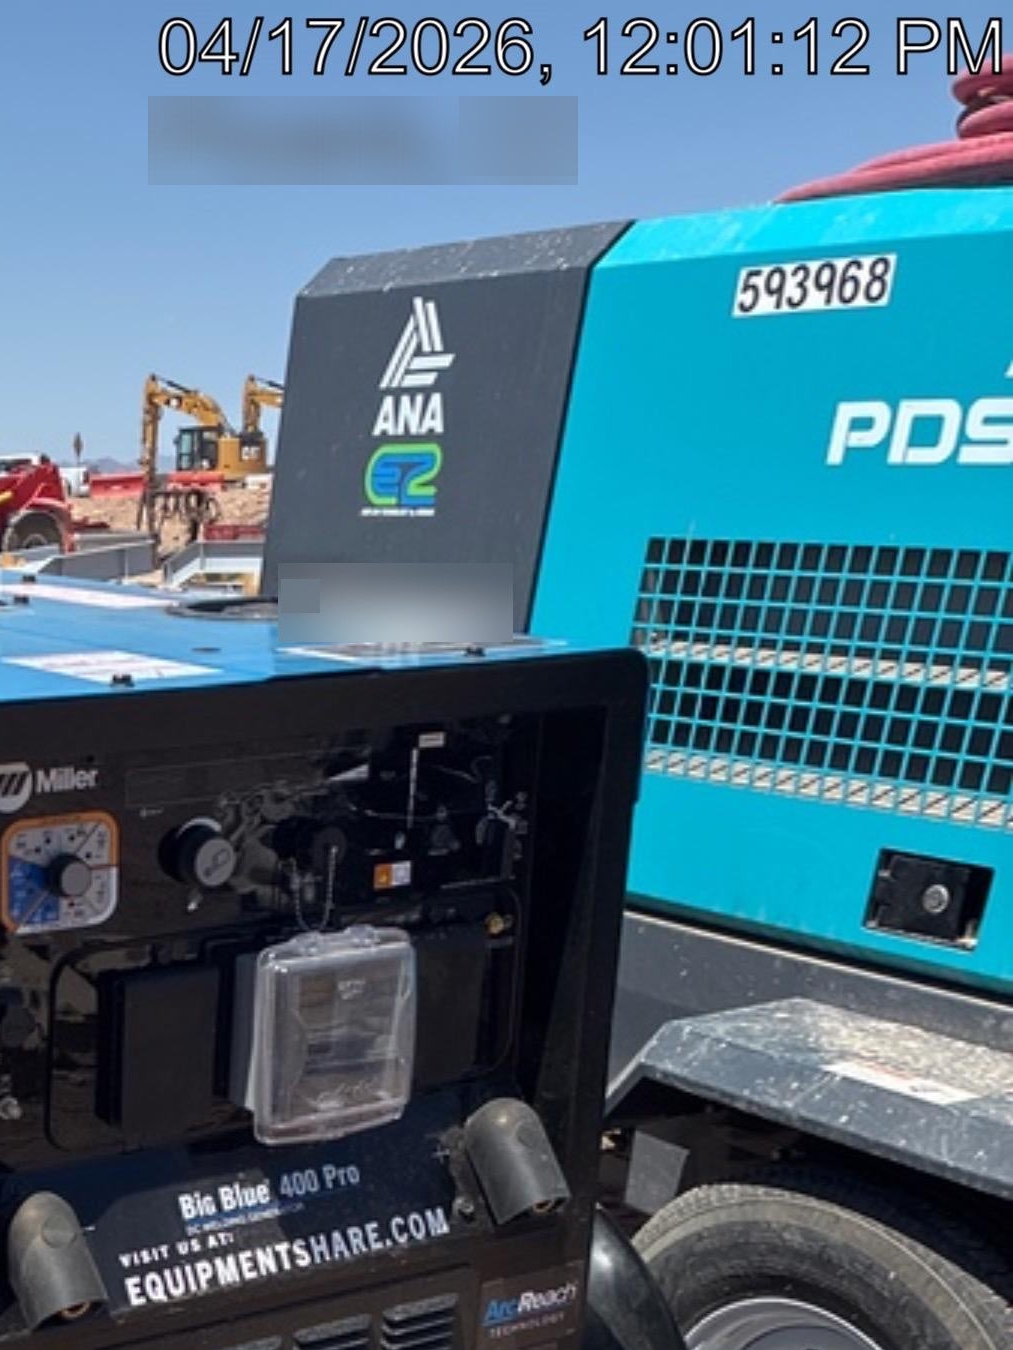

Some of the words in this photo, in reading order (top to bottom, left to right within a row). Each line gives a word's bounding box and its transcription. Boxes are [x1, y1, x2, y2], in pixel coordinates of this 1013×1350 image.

[737, 256, 891, 313] 593968
[372, 392, 444, 436] ANA
[826, 397, 1013, 466] PDS
[37, 766, 99, 793] Miller
[178, 1190, 217, 1219] Big
[218, 1181, 270, 1212] Blue
[280, 1168, 320, 1198] 400
[322, 1163, 360, 1189] Pro
[118, 1244, 169, 1268] VISIT
[176, 1238, 201, 1255] US
[124, 1206, 451, 1307] EQUIPMENTSHARE.COM
[483, 1282, 577, 1322] ArcReach
